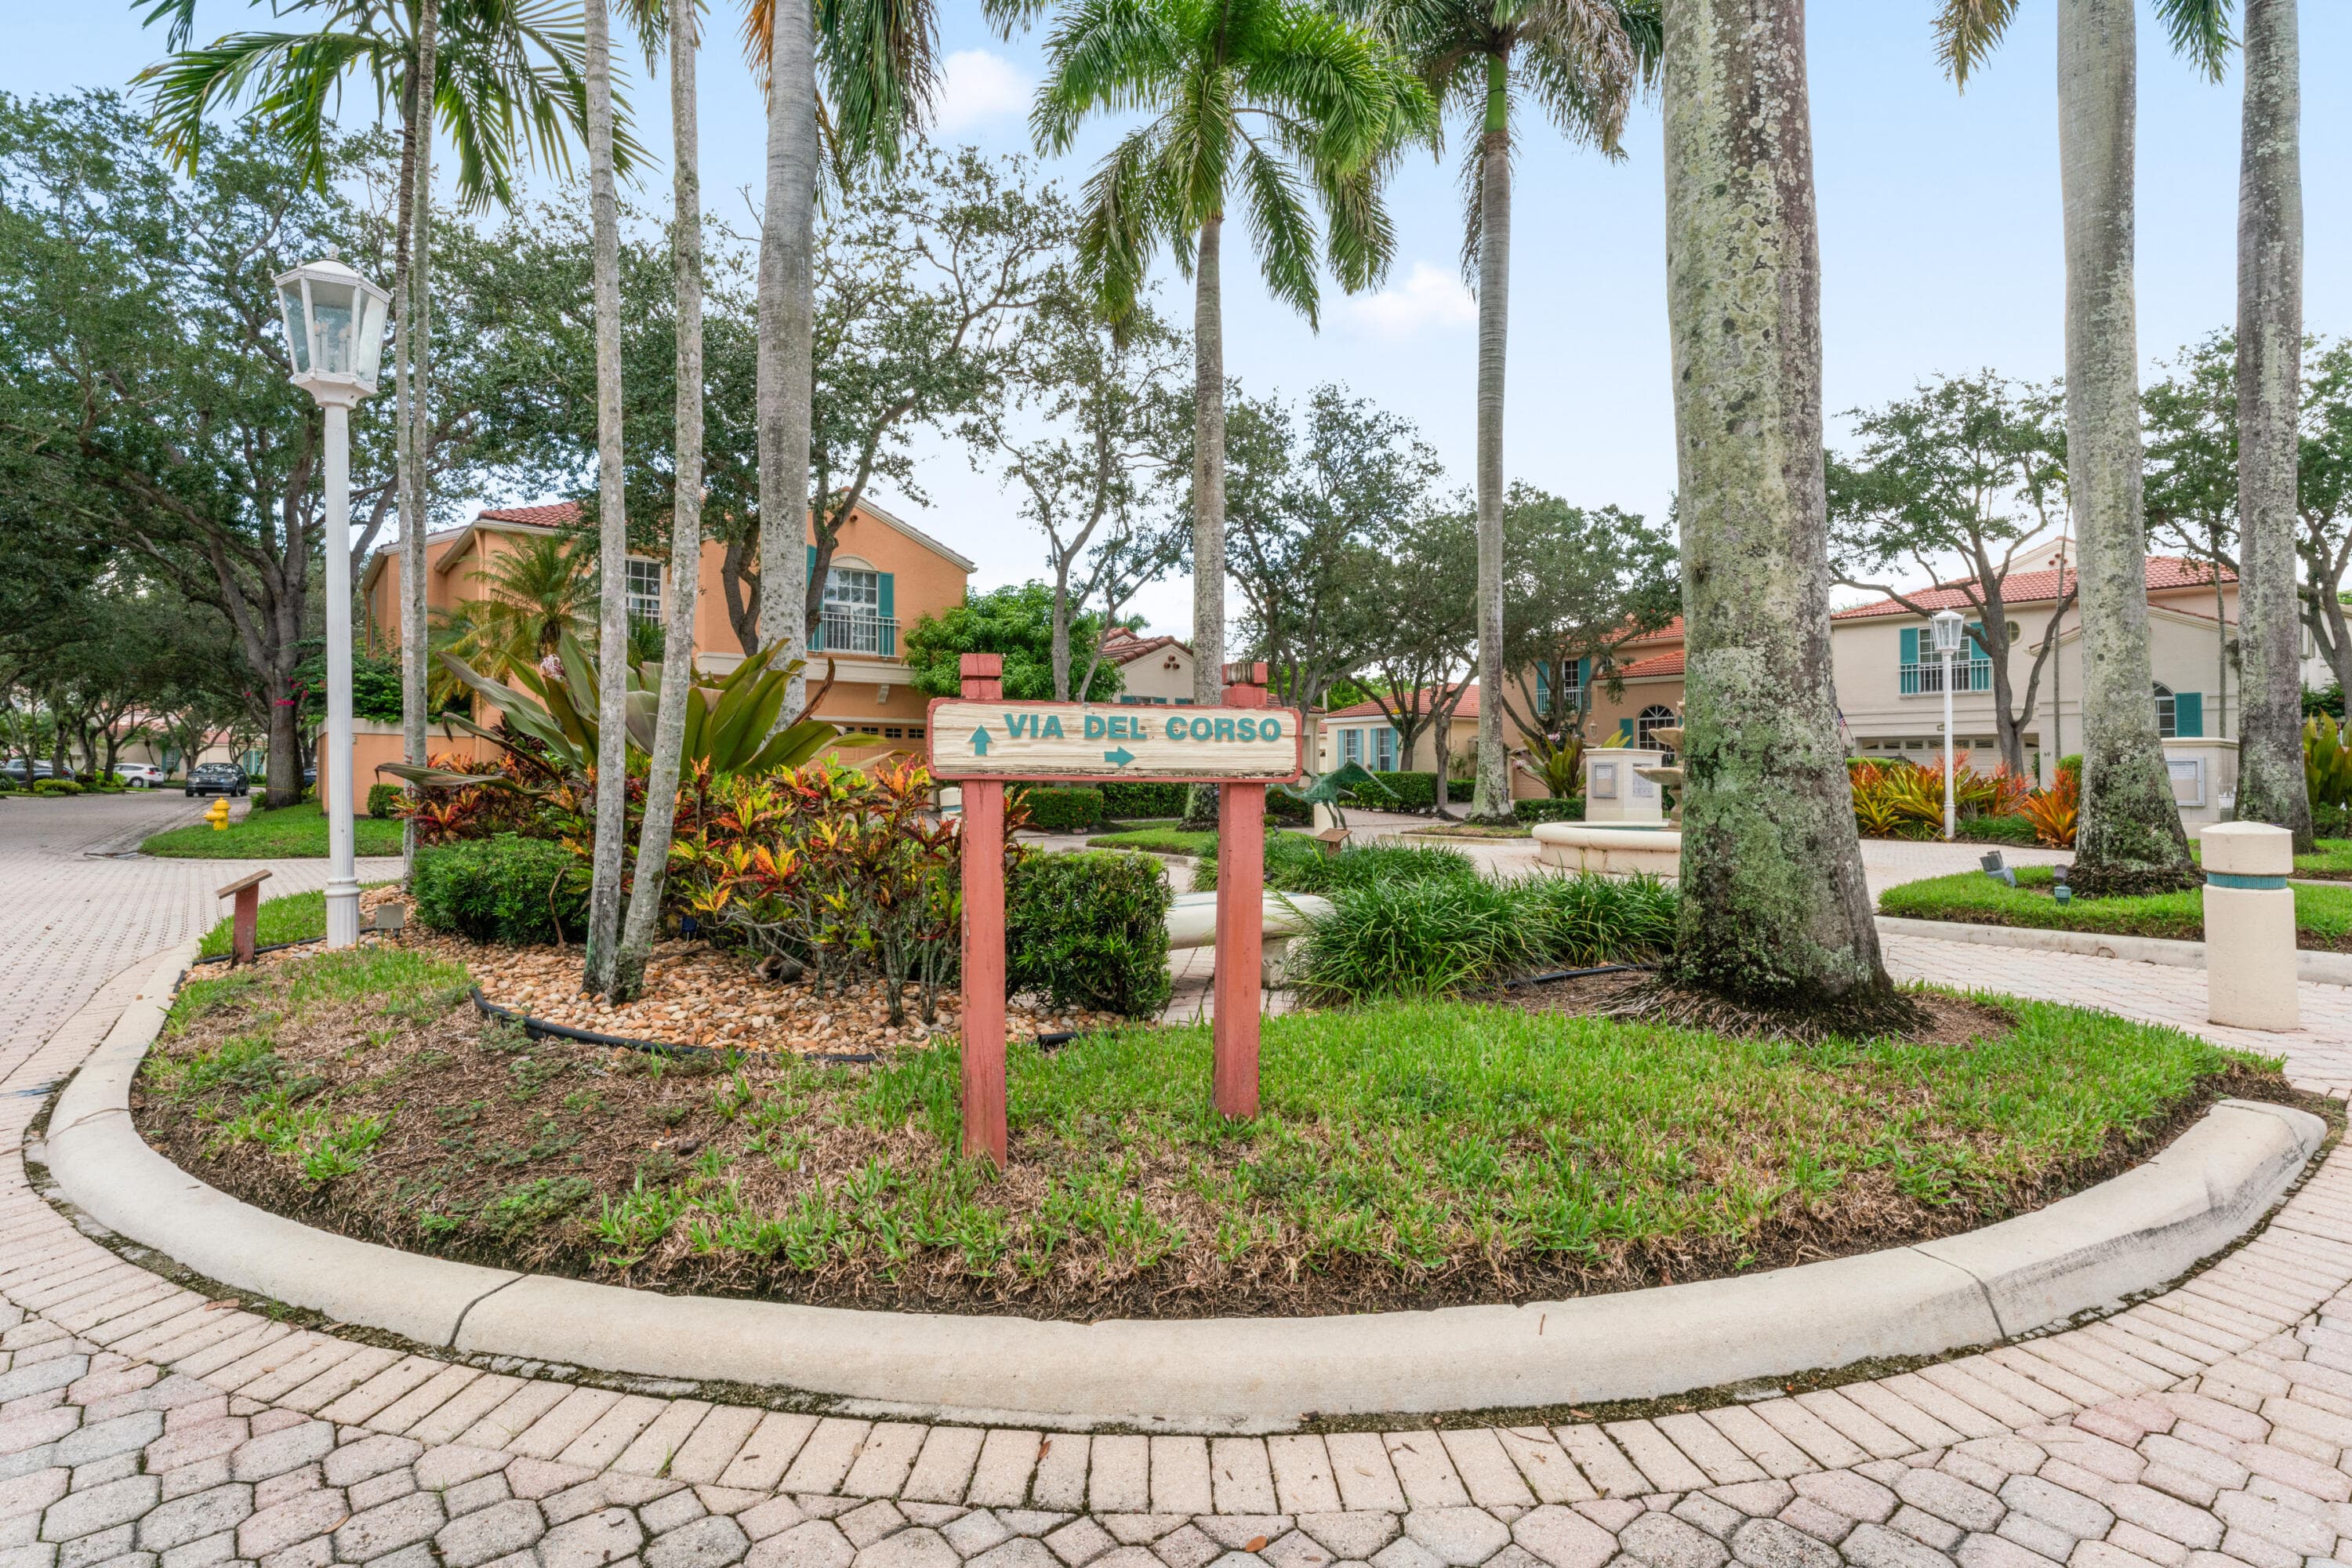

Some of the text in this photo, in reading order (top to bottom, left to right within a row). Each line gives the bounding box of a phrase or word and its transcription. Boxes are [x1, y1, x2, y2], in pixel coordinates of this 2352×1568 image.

[1004, 713, 1282, 742] VIA DEL CORSO
